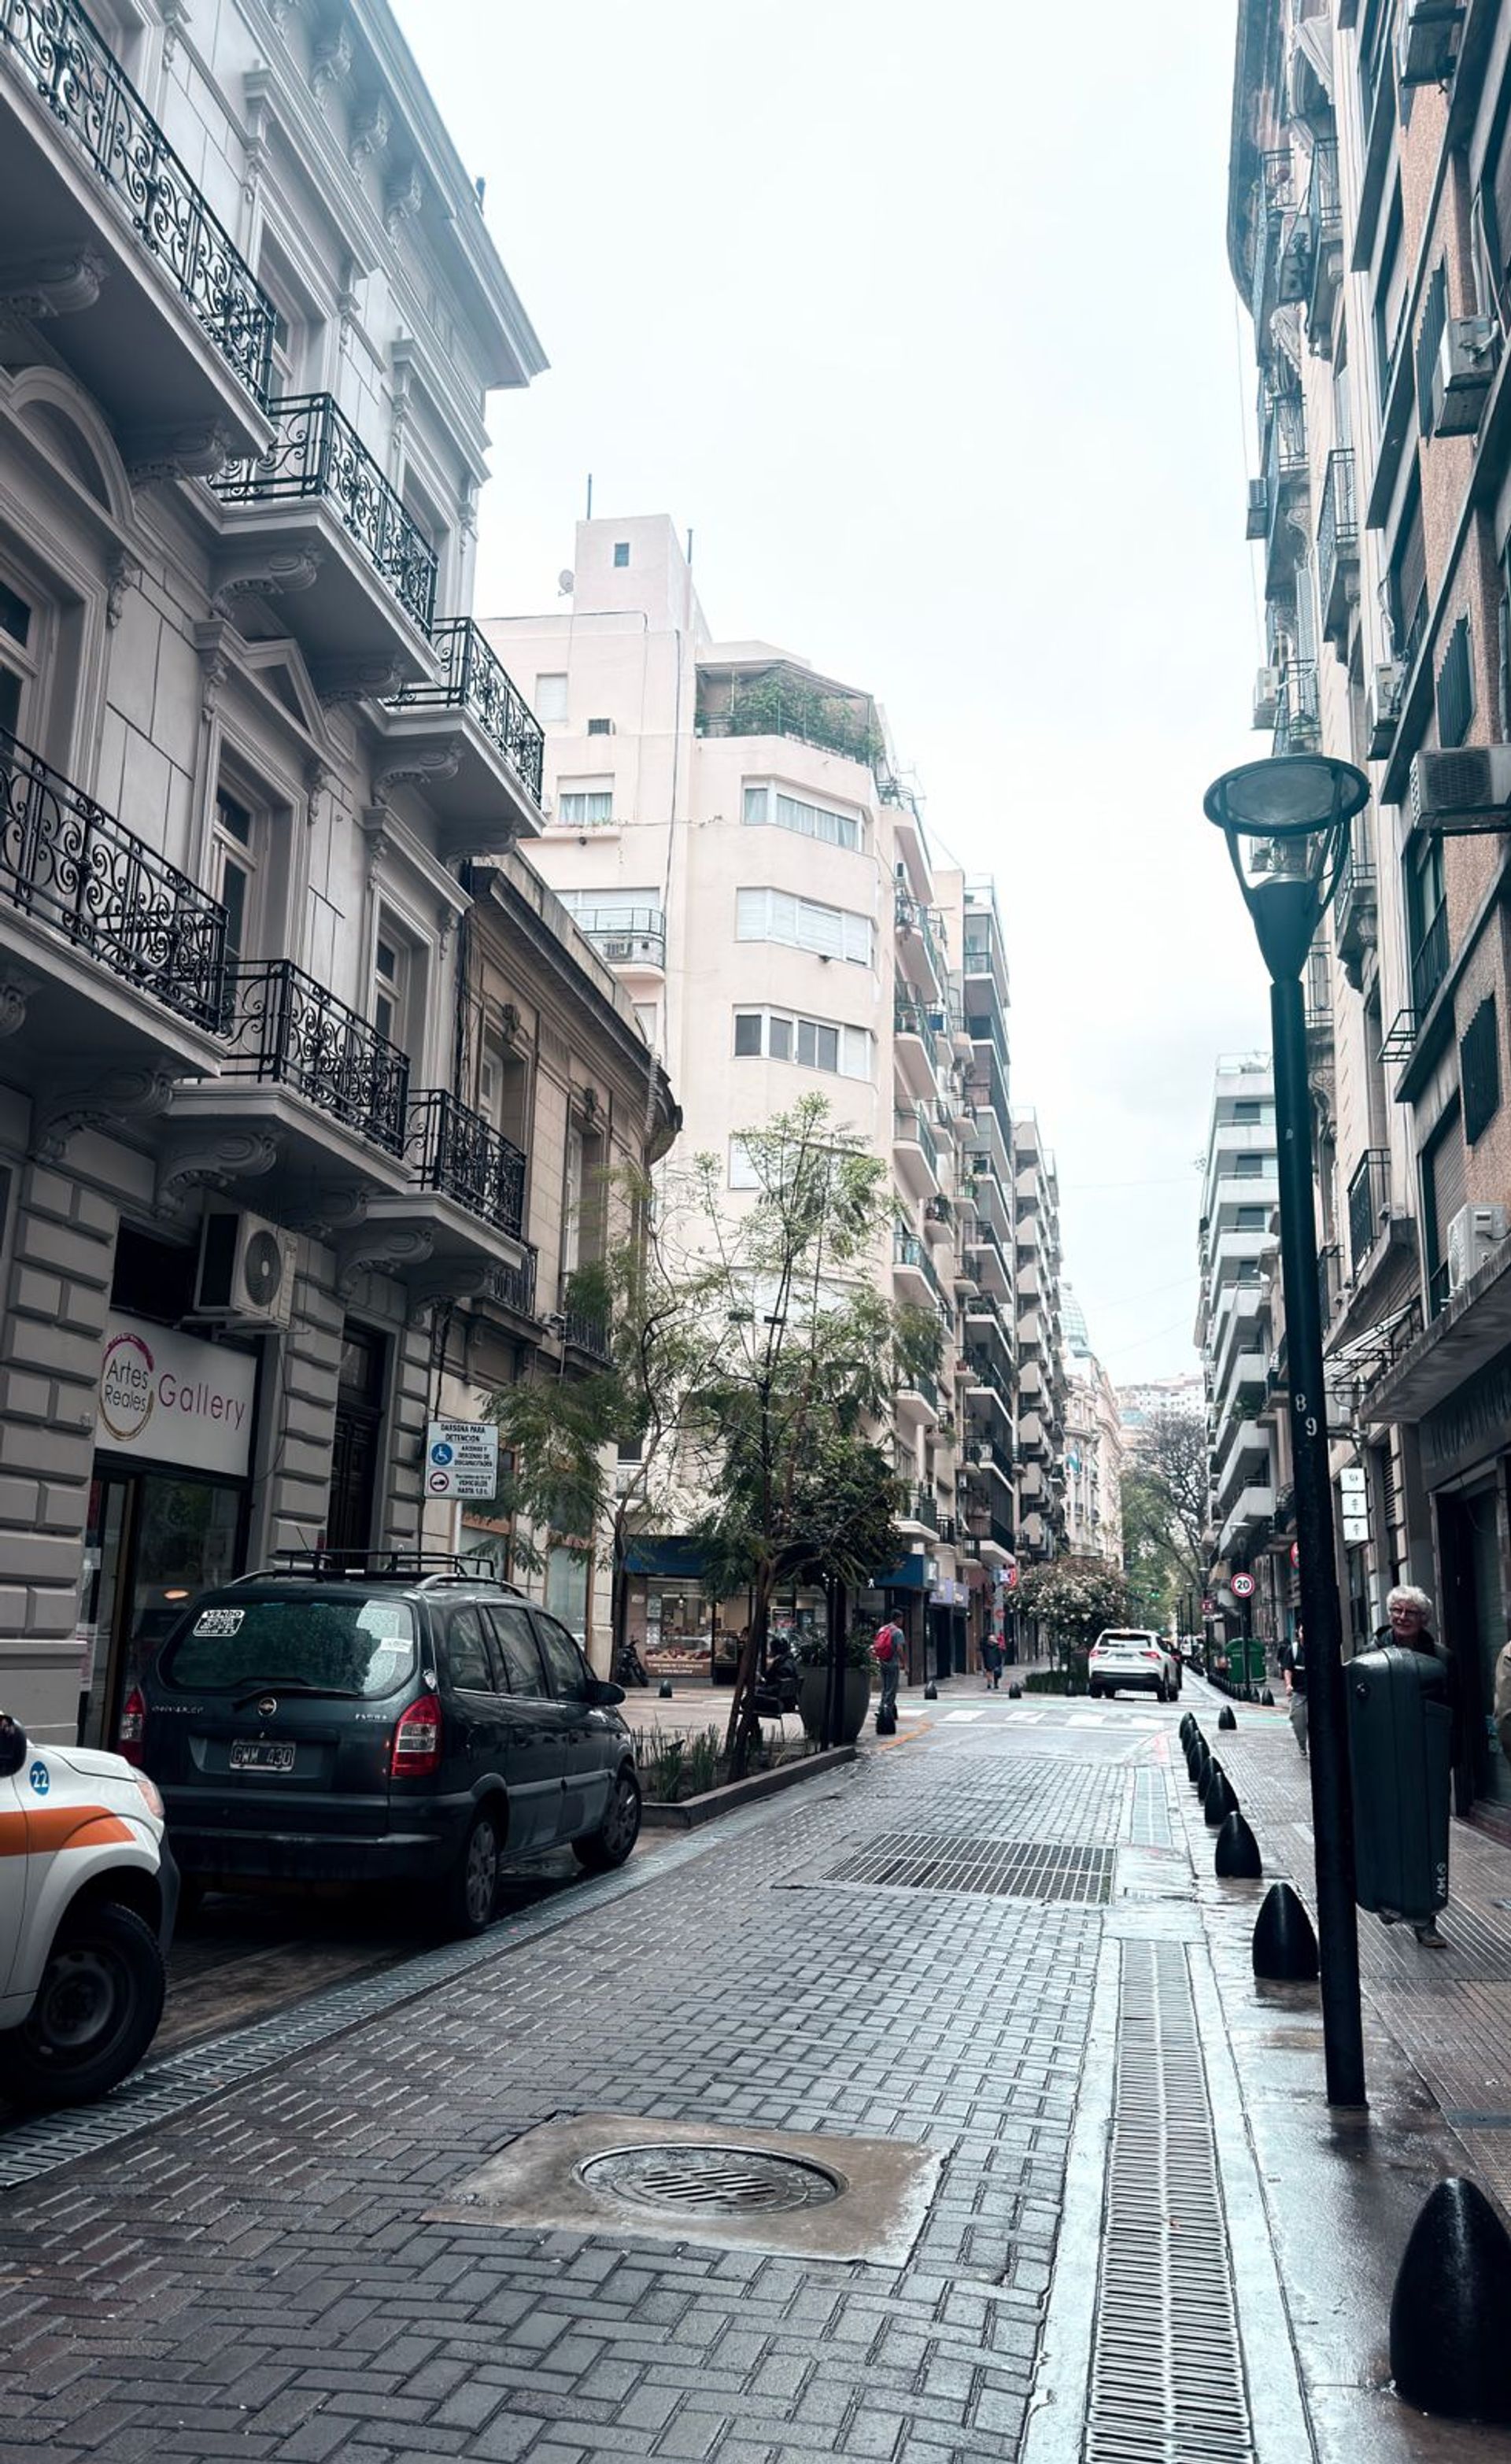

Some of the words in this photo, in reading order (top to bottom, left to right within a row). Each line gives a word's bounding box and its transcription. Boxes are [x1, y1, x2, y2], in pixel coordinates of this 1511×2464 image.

[106, 1358, 150, 1390] Artes
[104, 1383, 147, 1412] Reales
[158, 1373, 246, 1430] Gallery
[1236, 1579, 1250, 1590] 20
[31, 1770, 50, 1788] 22
